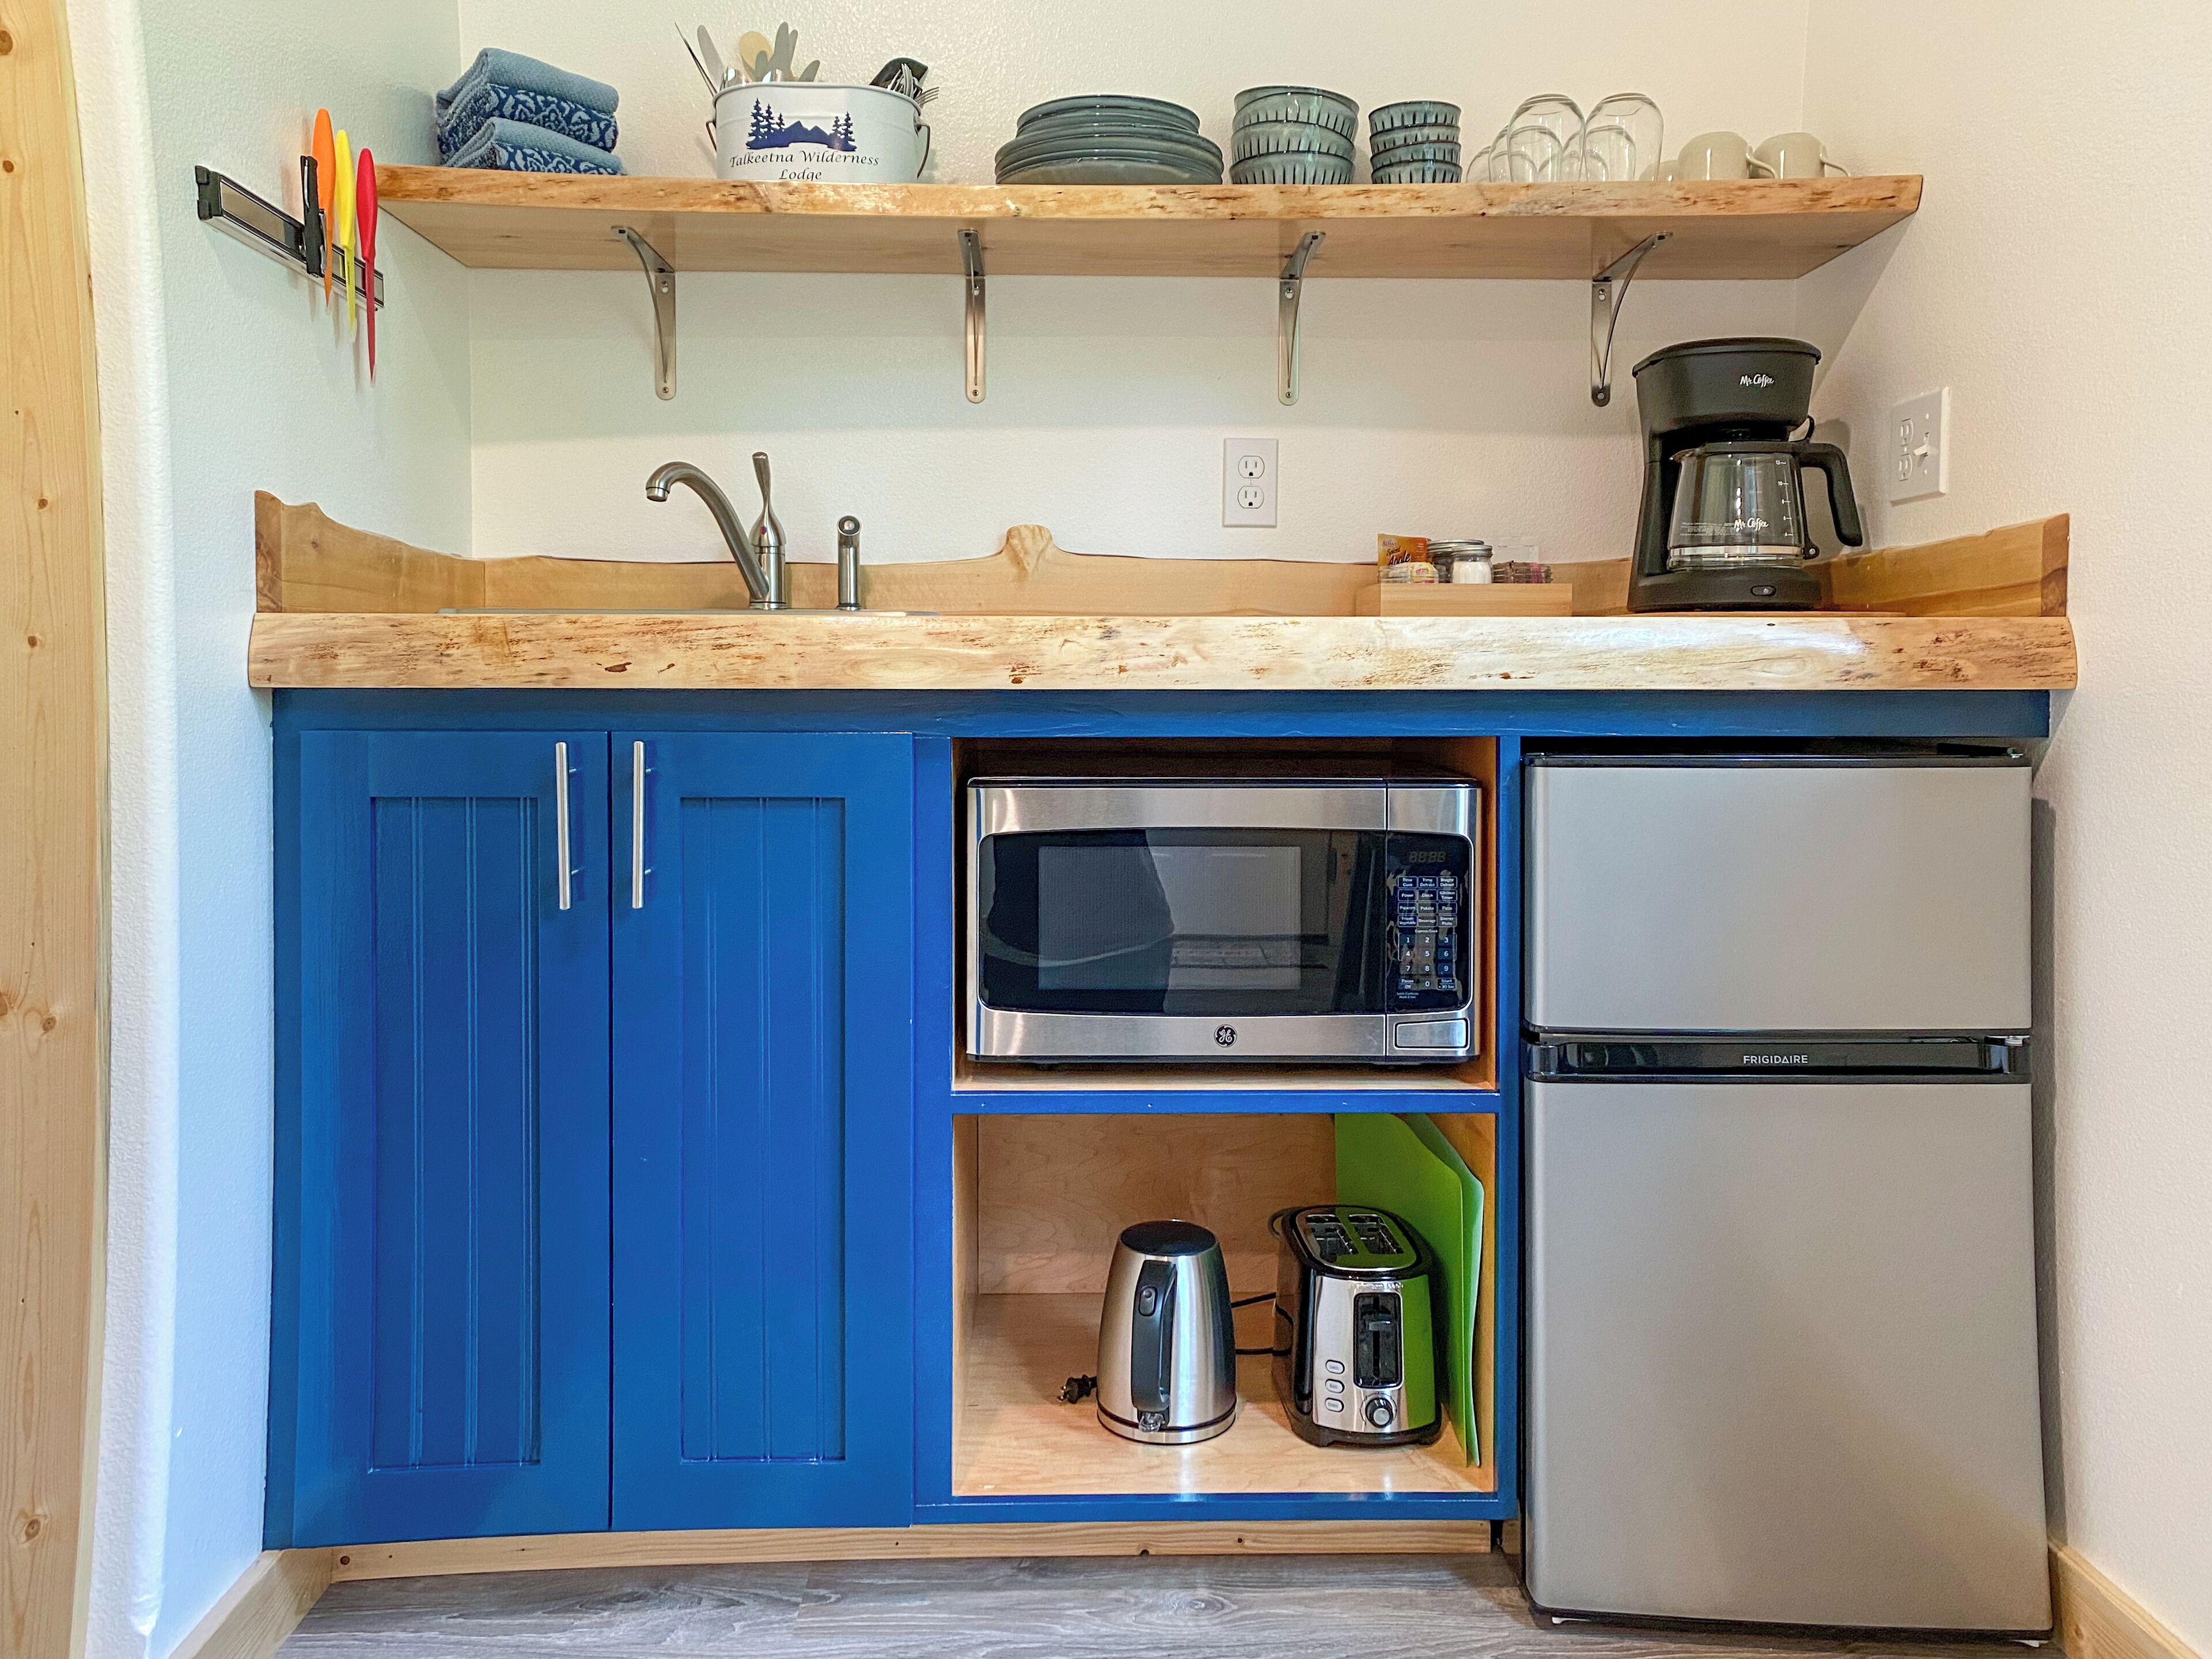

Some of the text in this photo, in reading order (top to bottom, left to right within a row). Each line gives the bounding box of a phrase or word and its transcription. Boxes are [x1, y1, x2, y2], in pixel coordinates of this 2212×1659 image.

[729, 150, 880, 168] Talkeetna Wilderness
[779, 168, 822, 181] Lodge
[1753, 373, 1775, 388] Coffee
[1747, 517, 1769, 531] Coffee
[1743, 1055, 1808, 1064] FRIGIDAIRE
